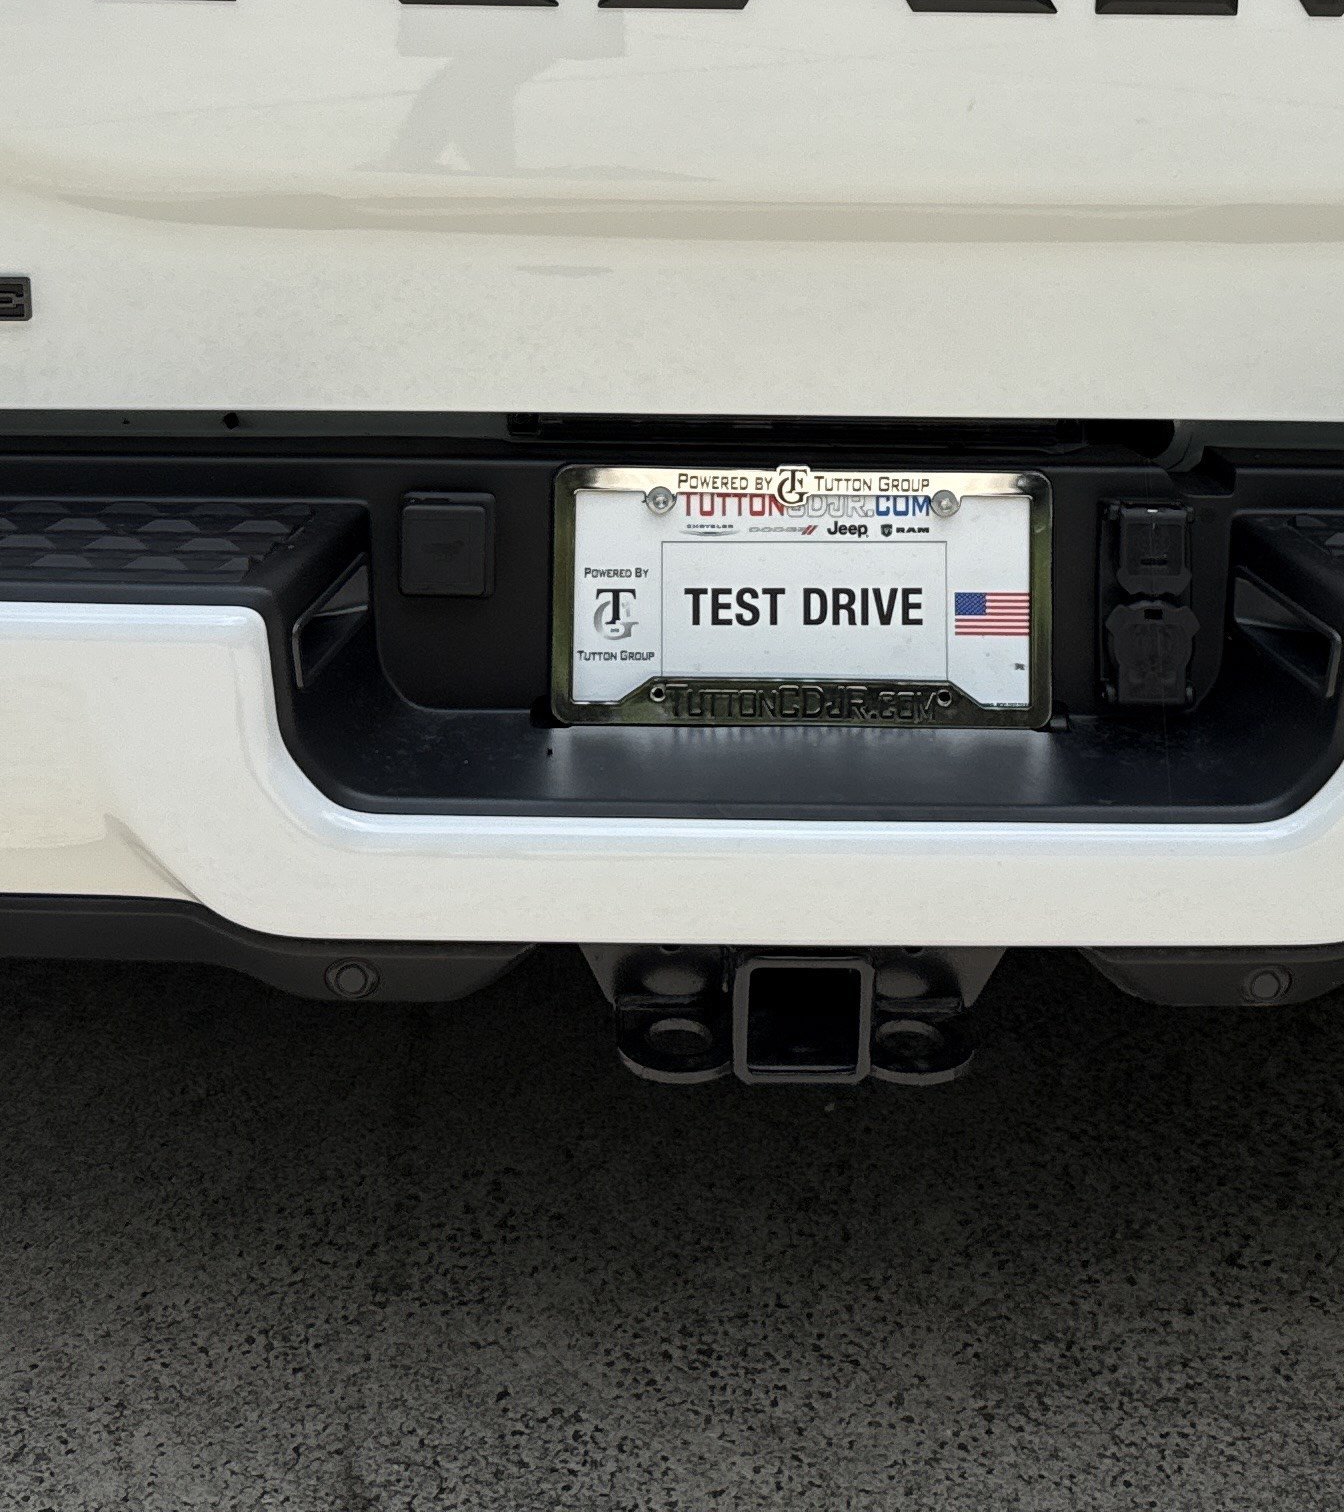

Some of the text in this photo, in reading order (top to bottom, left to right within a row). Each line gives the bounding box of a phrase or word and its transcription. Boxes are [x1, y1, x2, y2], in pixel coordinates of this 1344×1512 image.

[677, 472, 749, 490] POWERED
[754, 476, 773, 491] BY
[814, 475, 873, 492] TUTTON
[878, 476, 930, 493] GROUP
[827, 520, 868, 539] Jeep
[584, 567, 632, 578] POWERED
[684, 587, 923, 626] TEST DRIVE
[577, 649, 655, 661] TUTTON GROUP
